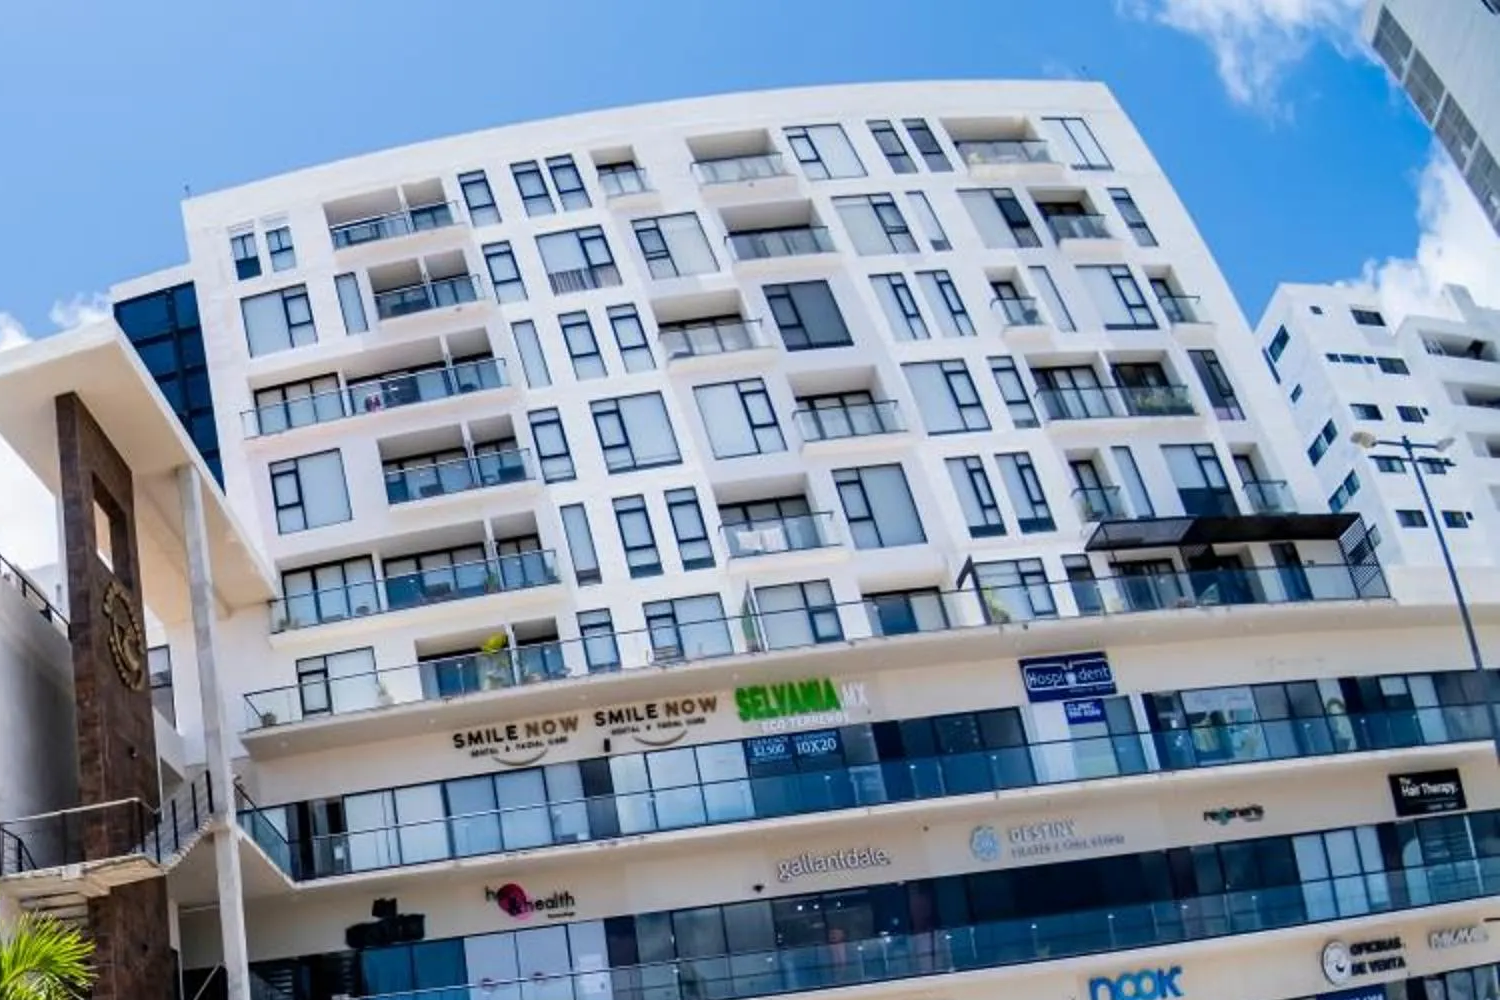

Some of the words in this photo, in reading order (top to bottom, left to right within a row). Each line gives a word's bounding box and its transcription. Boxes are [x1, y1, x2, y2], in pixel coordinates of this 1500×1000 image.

[593, 703, 658, 727] SMILE
[664, 696, 718, 718] NOW
[452, 725, 518, 750] SMILE
[525, 716, 580, 738] NOW
[1370, 956, 1406, 973] VENTA
